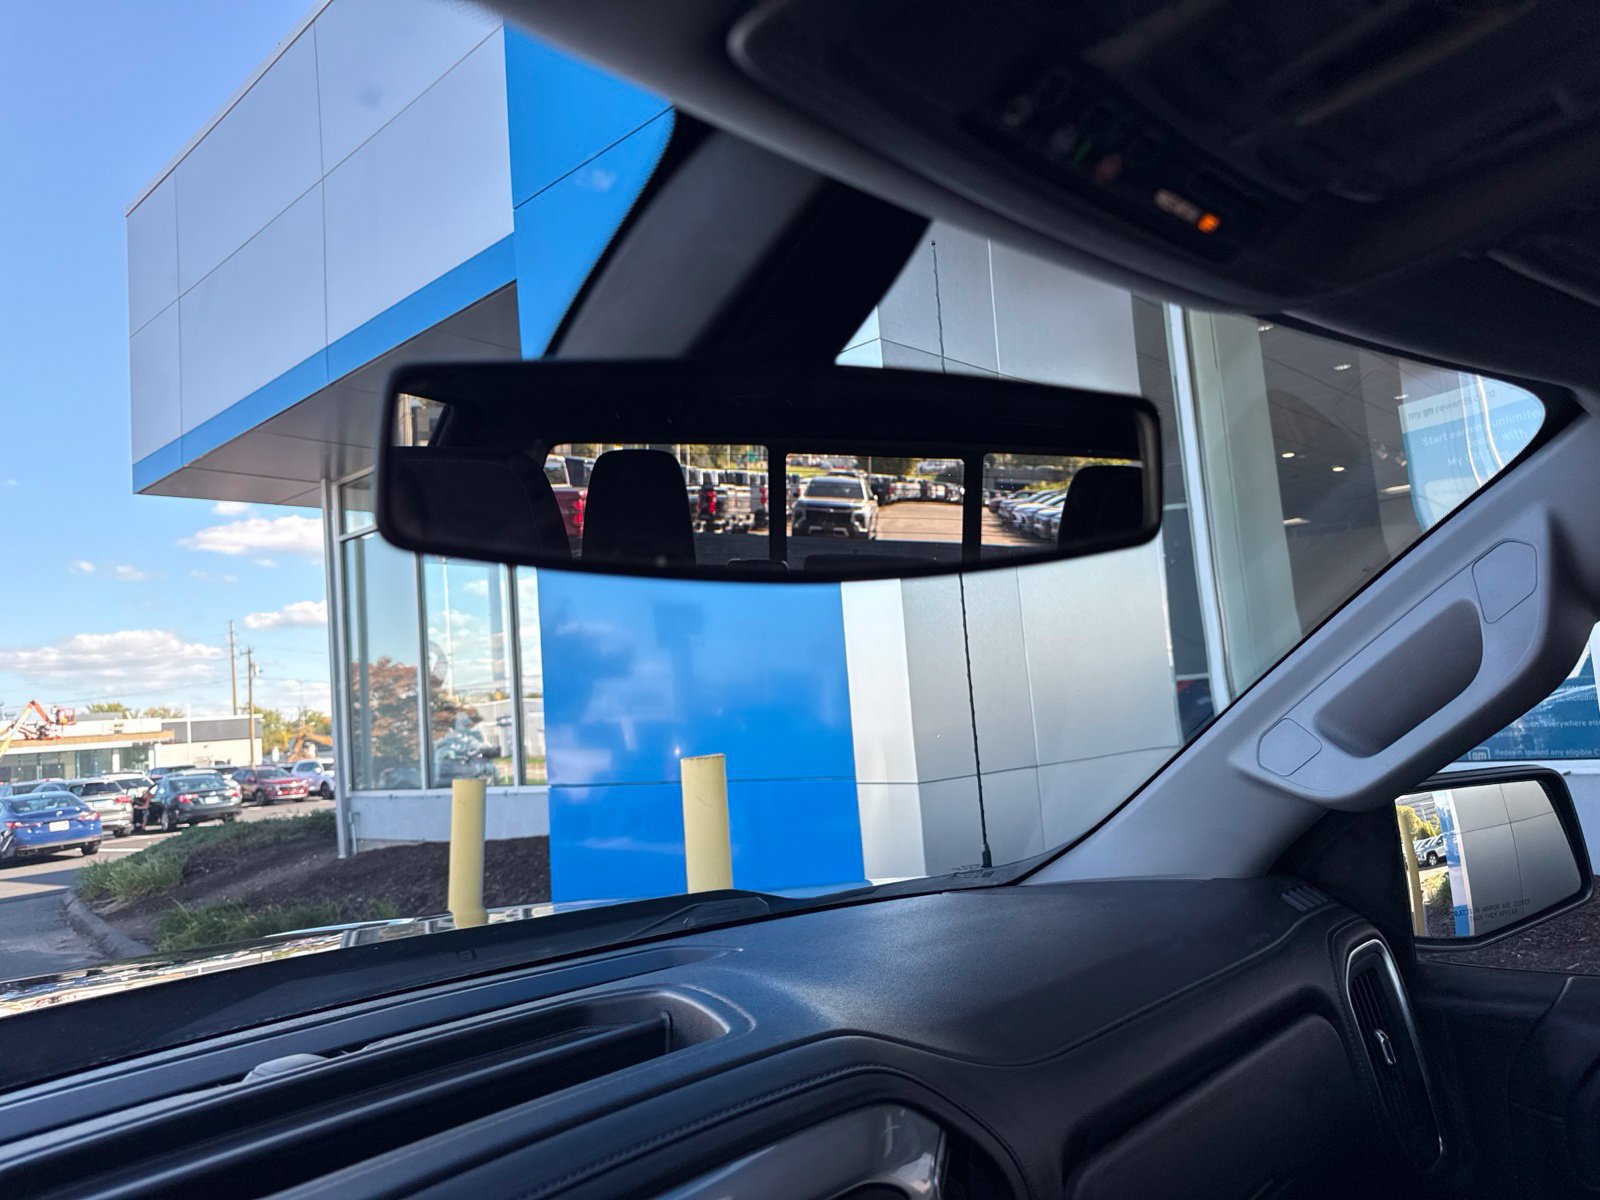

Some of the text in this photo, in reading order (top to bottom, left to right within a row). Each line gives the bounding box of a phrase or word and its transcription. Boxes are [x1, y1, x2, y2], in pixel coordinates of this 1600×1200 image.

[1408, 410, 1422, 420] my
[1474, 388, 1496, 402] crd
[1422, 432, 1448, 446] Start
[1501, 428, 1528, 443] with
[1550, 750, 1564, 758] any
